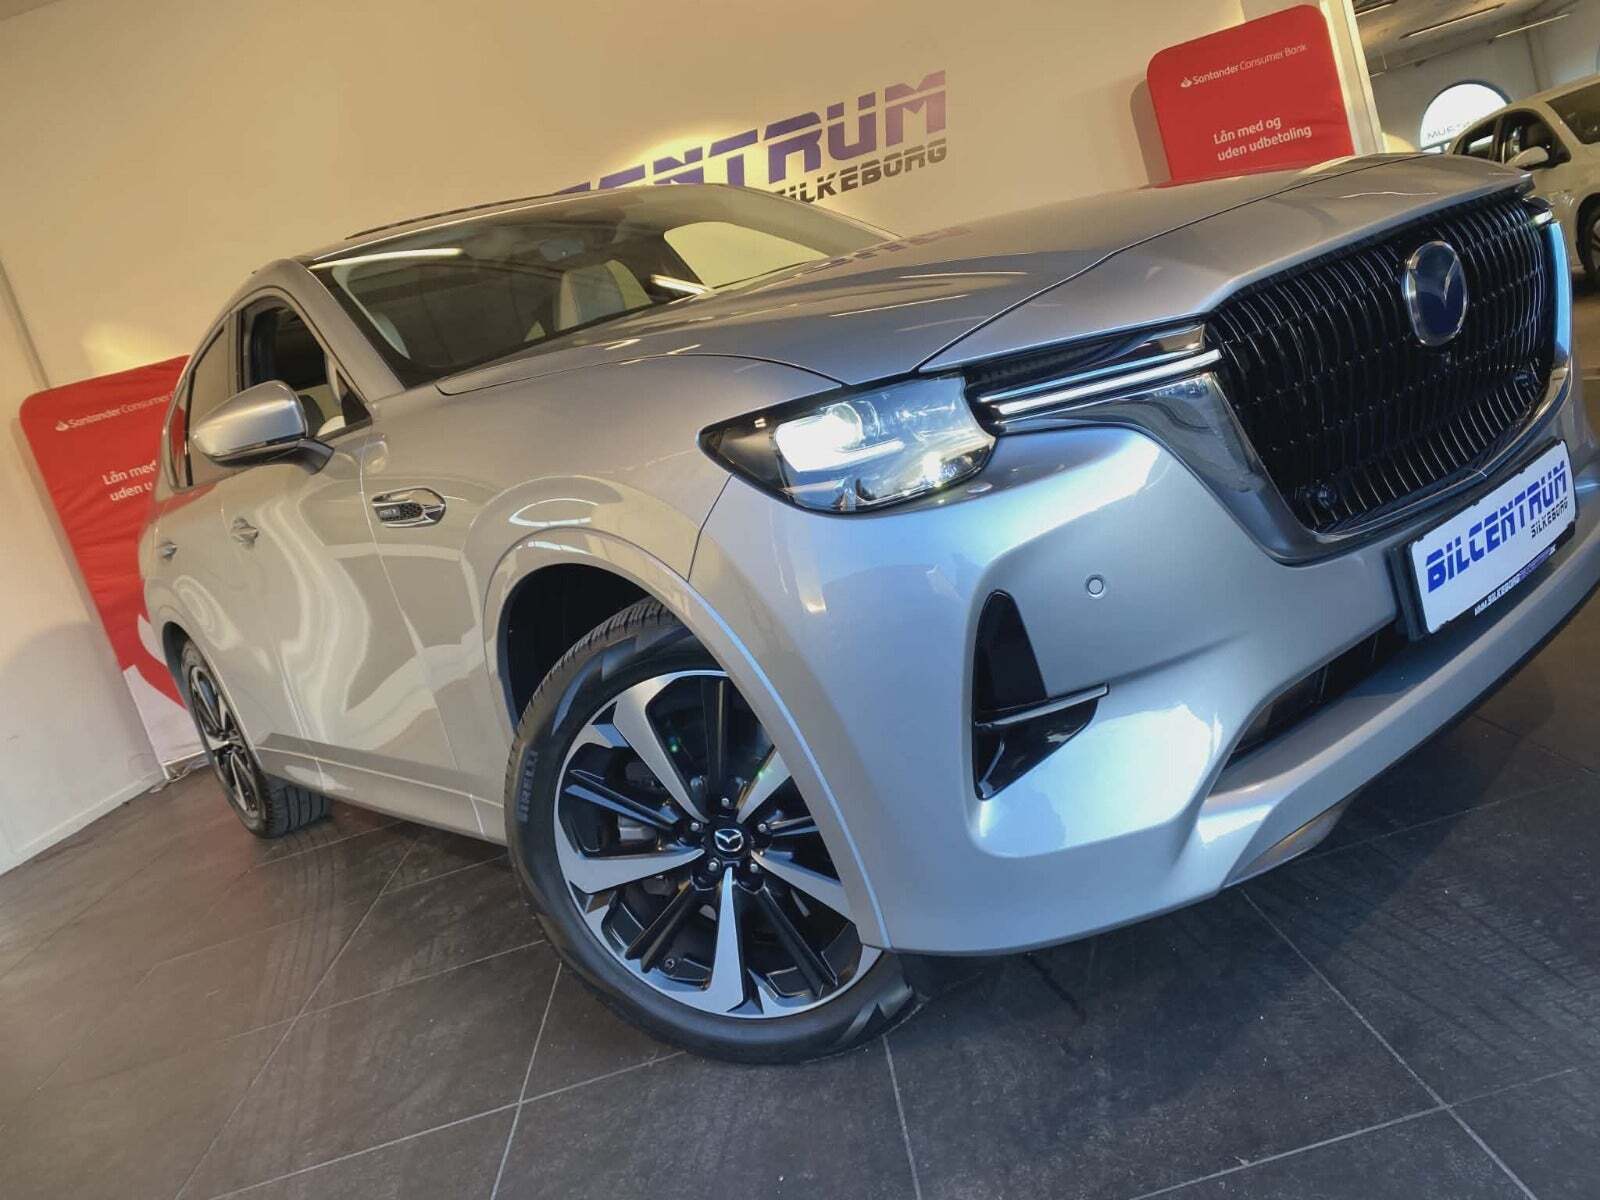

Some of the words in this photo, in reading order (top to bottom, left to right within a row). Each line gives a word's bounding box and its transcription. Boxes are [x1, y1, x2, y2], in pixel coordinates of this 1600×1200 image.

[1193, 64, 1239, 85] Santander
[1240, 52, 1283, 70] Consumer
[1284, 44, 1306, 57] Bank
[1213, 130, 1235, 145] Lån
[1237, 119, 1264, 138] med
[1265, 117, 1282, 130] og
[1217, 146, 1247, 161] uden
[1248, 125, 1312, 152] udbetaling
[68, 408, 120, 428] Santander
[102, 470, 128, 485] Lån
[110, 485, 143, 501] uden
[1425, 460, 1567, 593] BILCENTRUM
[1531, 497, 1568, 538] SILKEBORG
